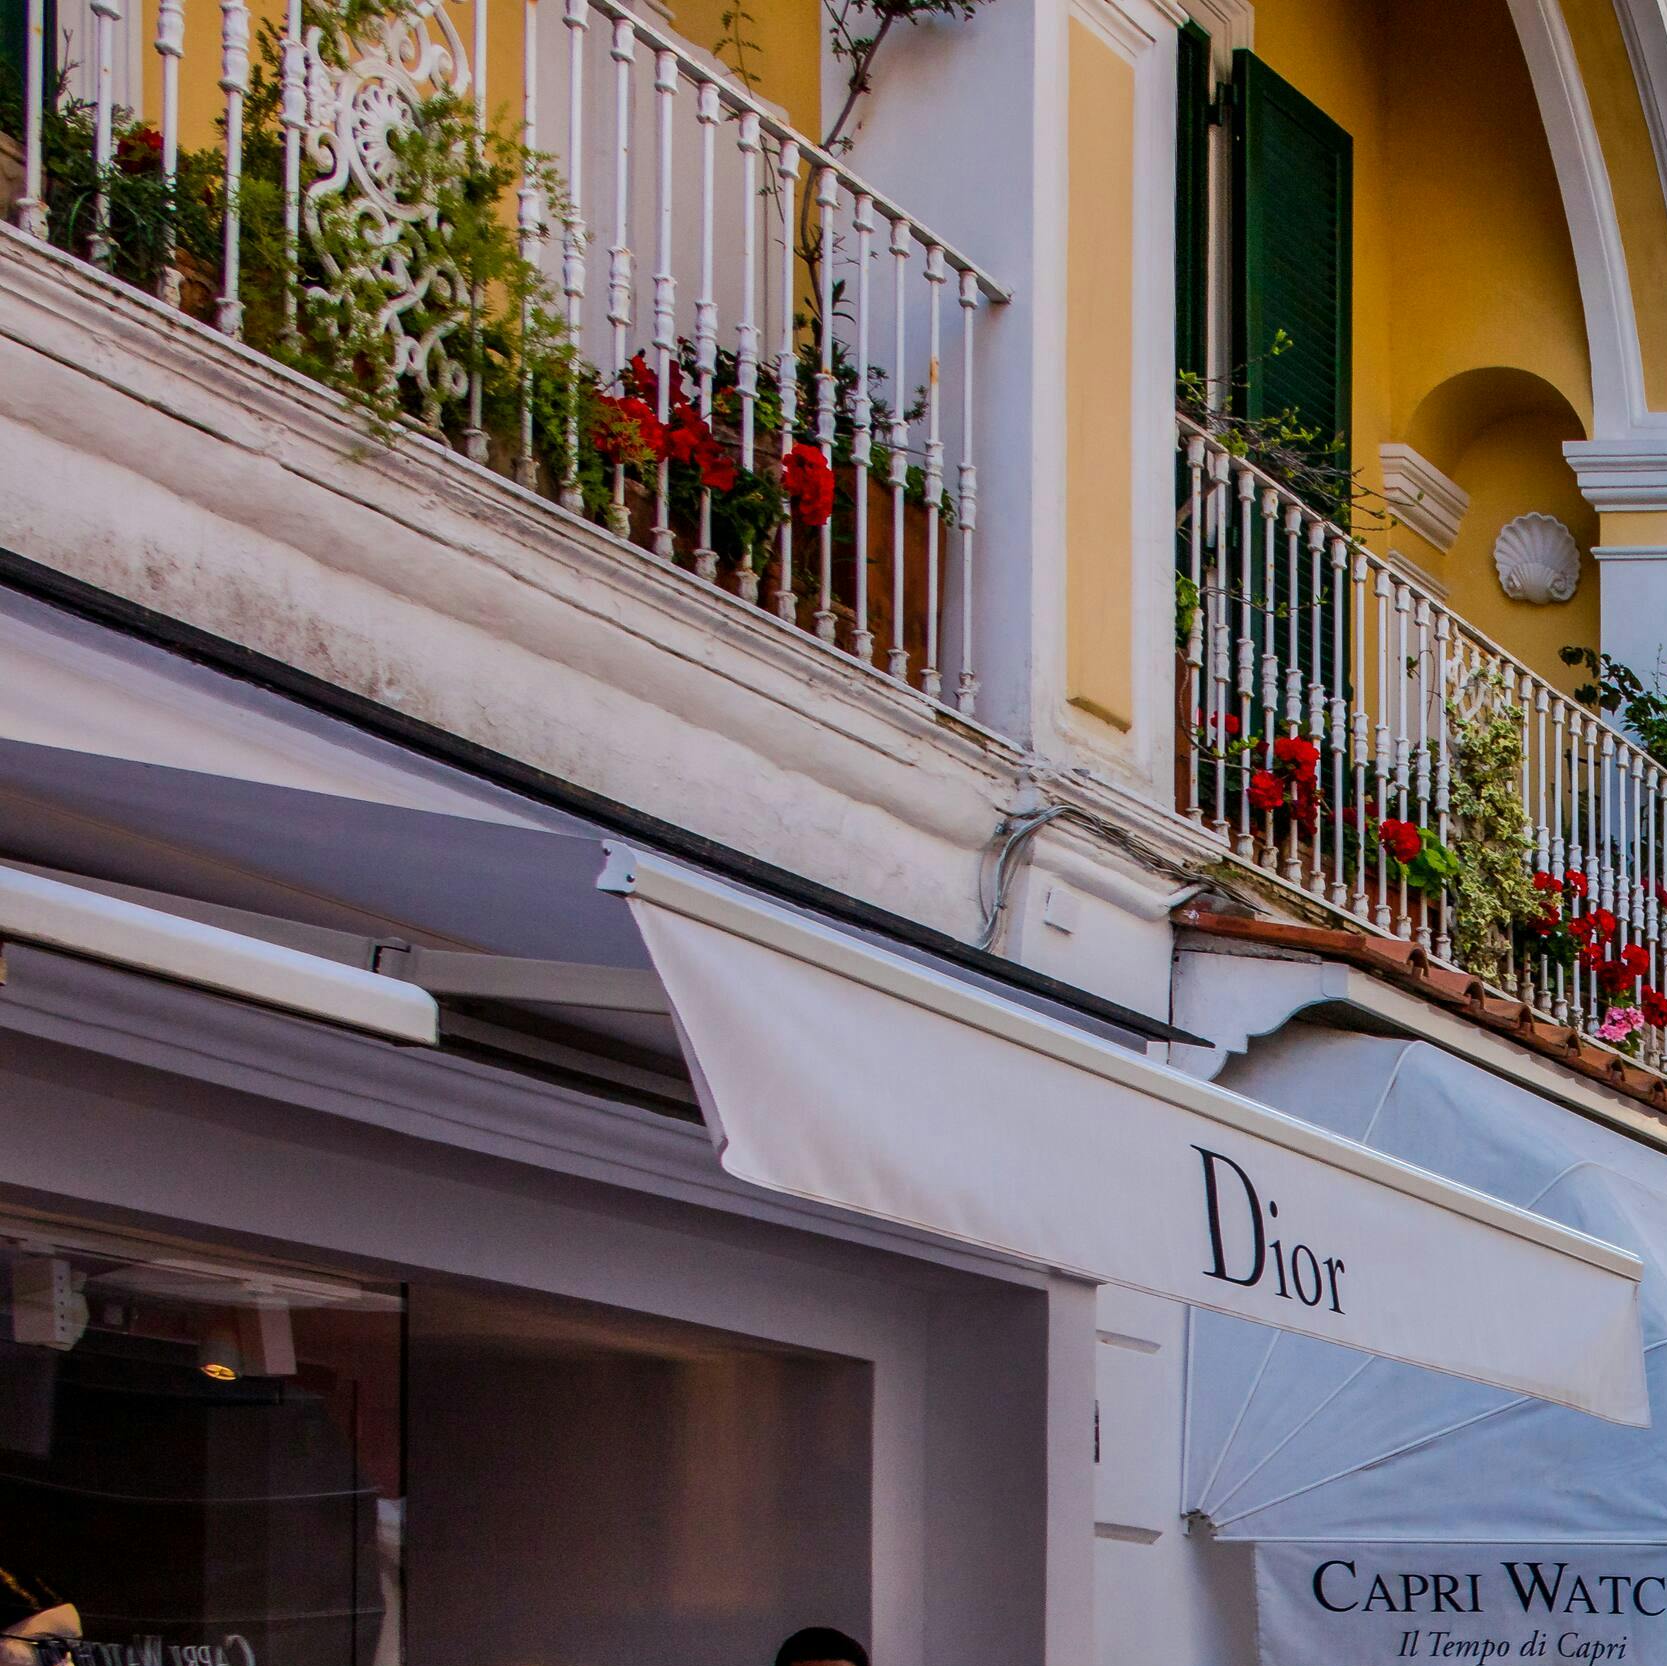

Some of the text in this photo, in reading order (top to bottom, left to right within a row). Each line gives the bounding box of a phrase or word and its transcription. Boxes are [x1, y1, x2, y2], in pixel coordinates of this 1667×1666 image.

[1189, 1143, 1347, 1316] Dior
[1312, 1559, 1483, 1613] CAPRI
[1397, 1630, 1420, 1658] Il
[1428, 1630, 1510, 1666] Tempo
[1519, 1629, 1547, 1657] di
